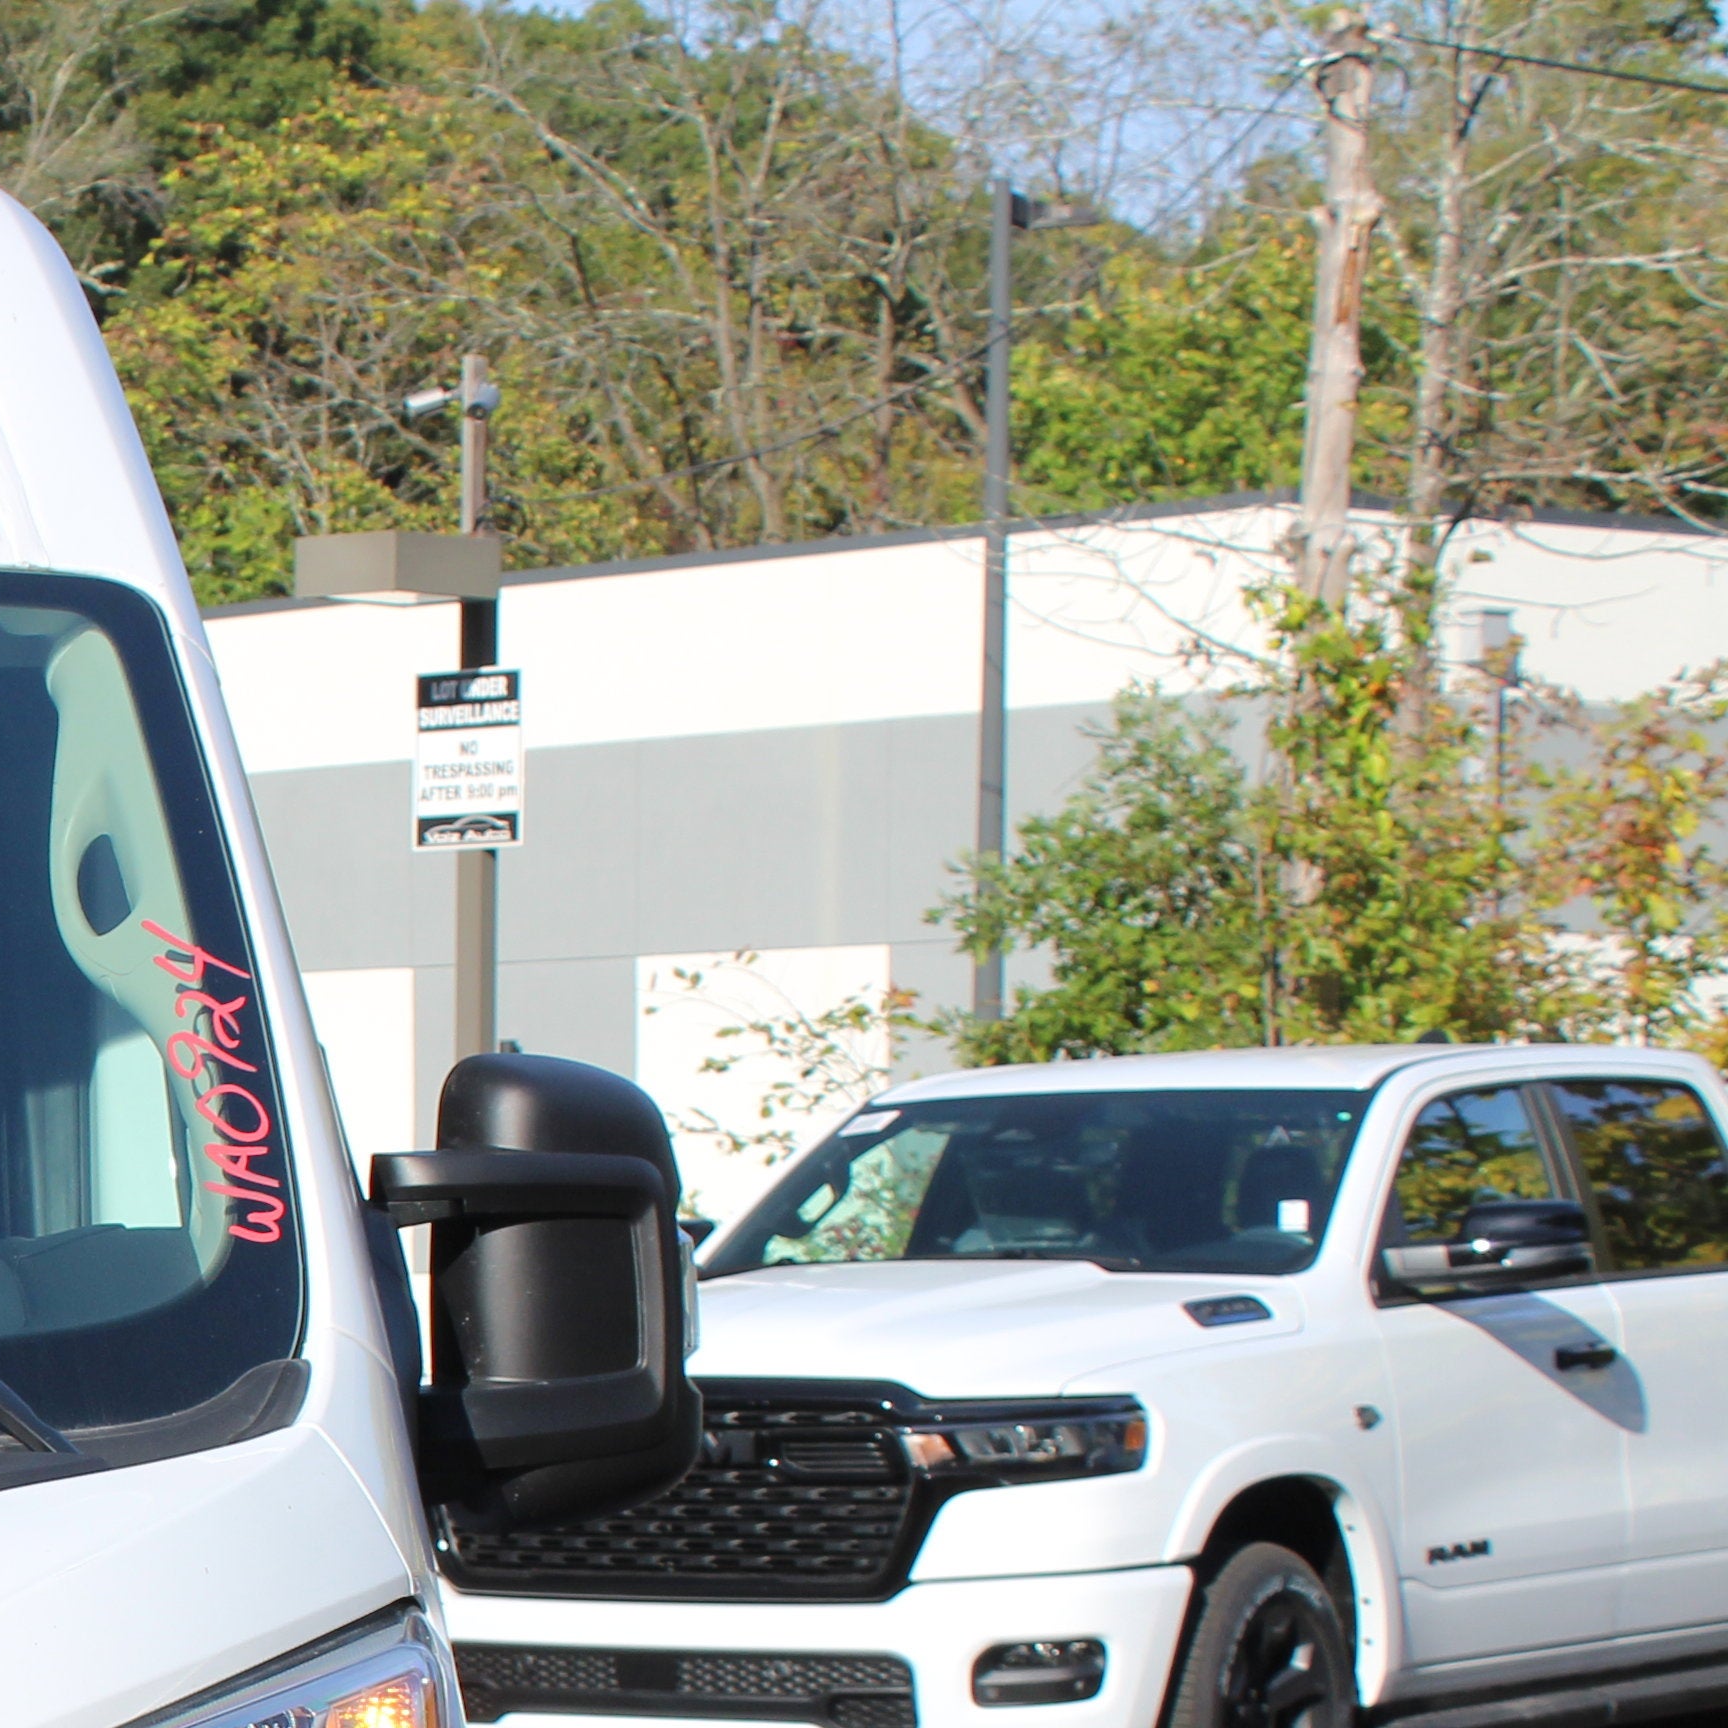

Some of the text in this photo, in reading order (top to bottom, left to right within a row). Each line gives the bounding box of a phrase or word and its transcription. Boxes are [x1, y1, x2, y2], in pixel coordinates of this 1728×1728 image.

[431, 676, 509, 701] LOT UNDER
[419, 701, 520, 728] SURVEILLANCE
[458, 740, 479, 757] NO
[423, 760, 514, 780] TRESPASSING
[420, 782, 519, 803] AFTER 9:00 pm
[1427, 1540, 1491, 1565] RAM
